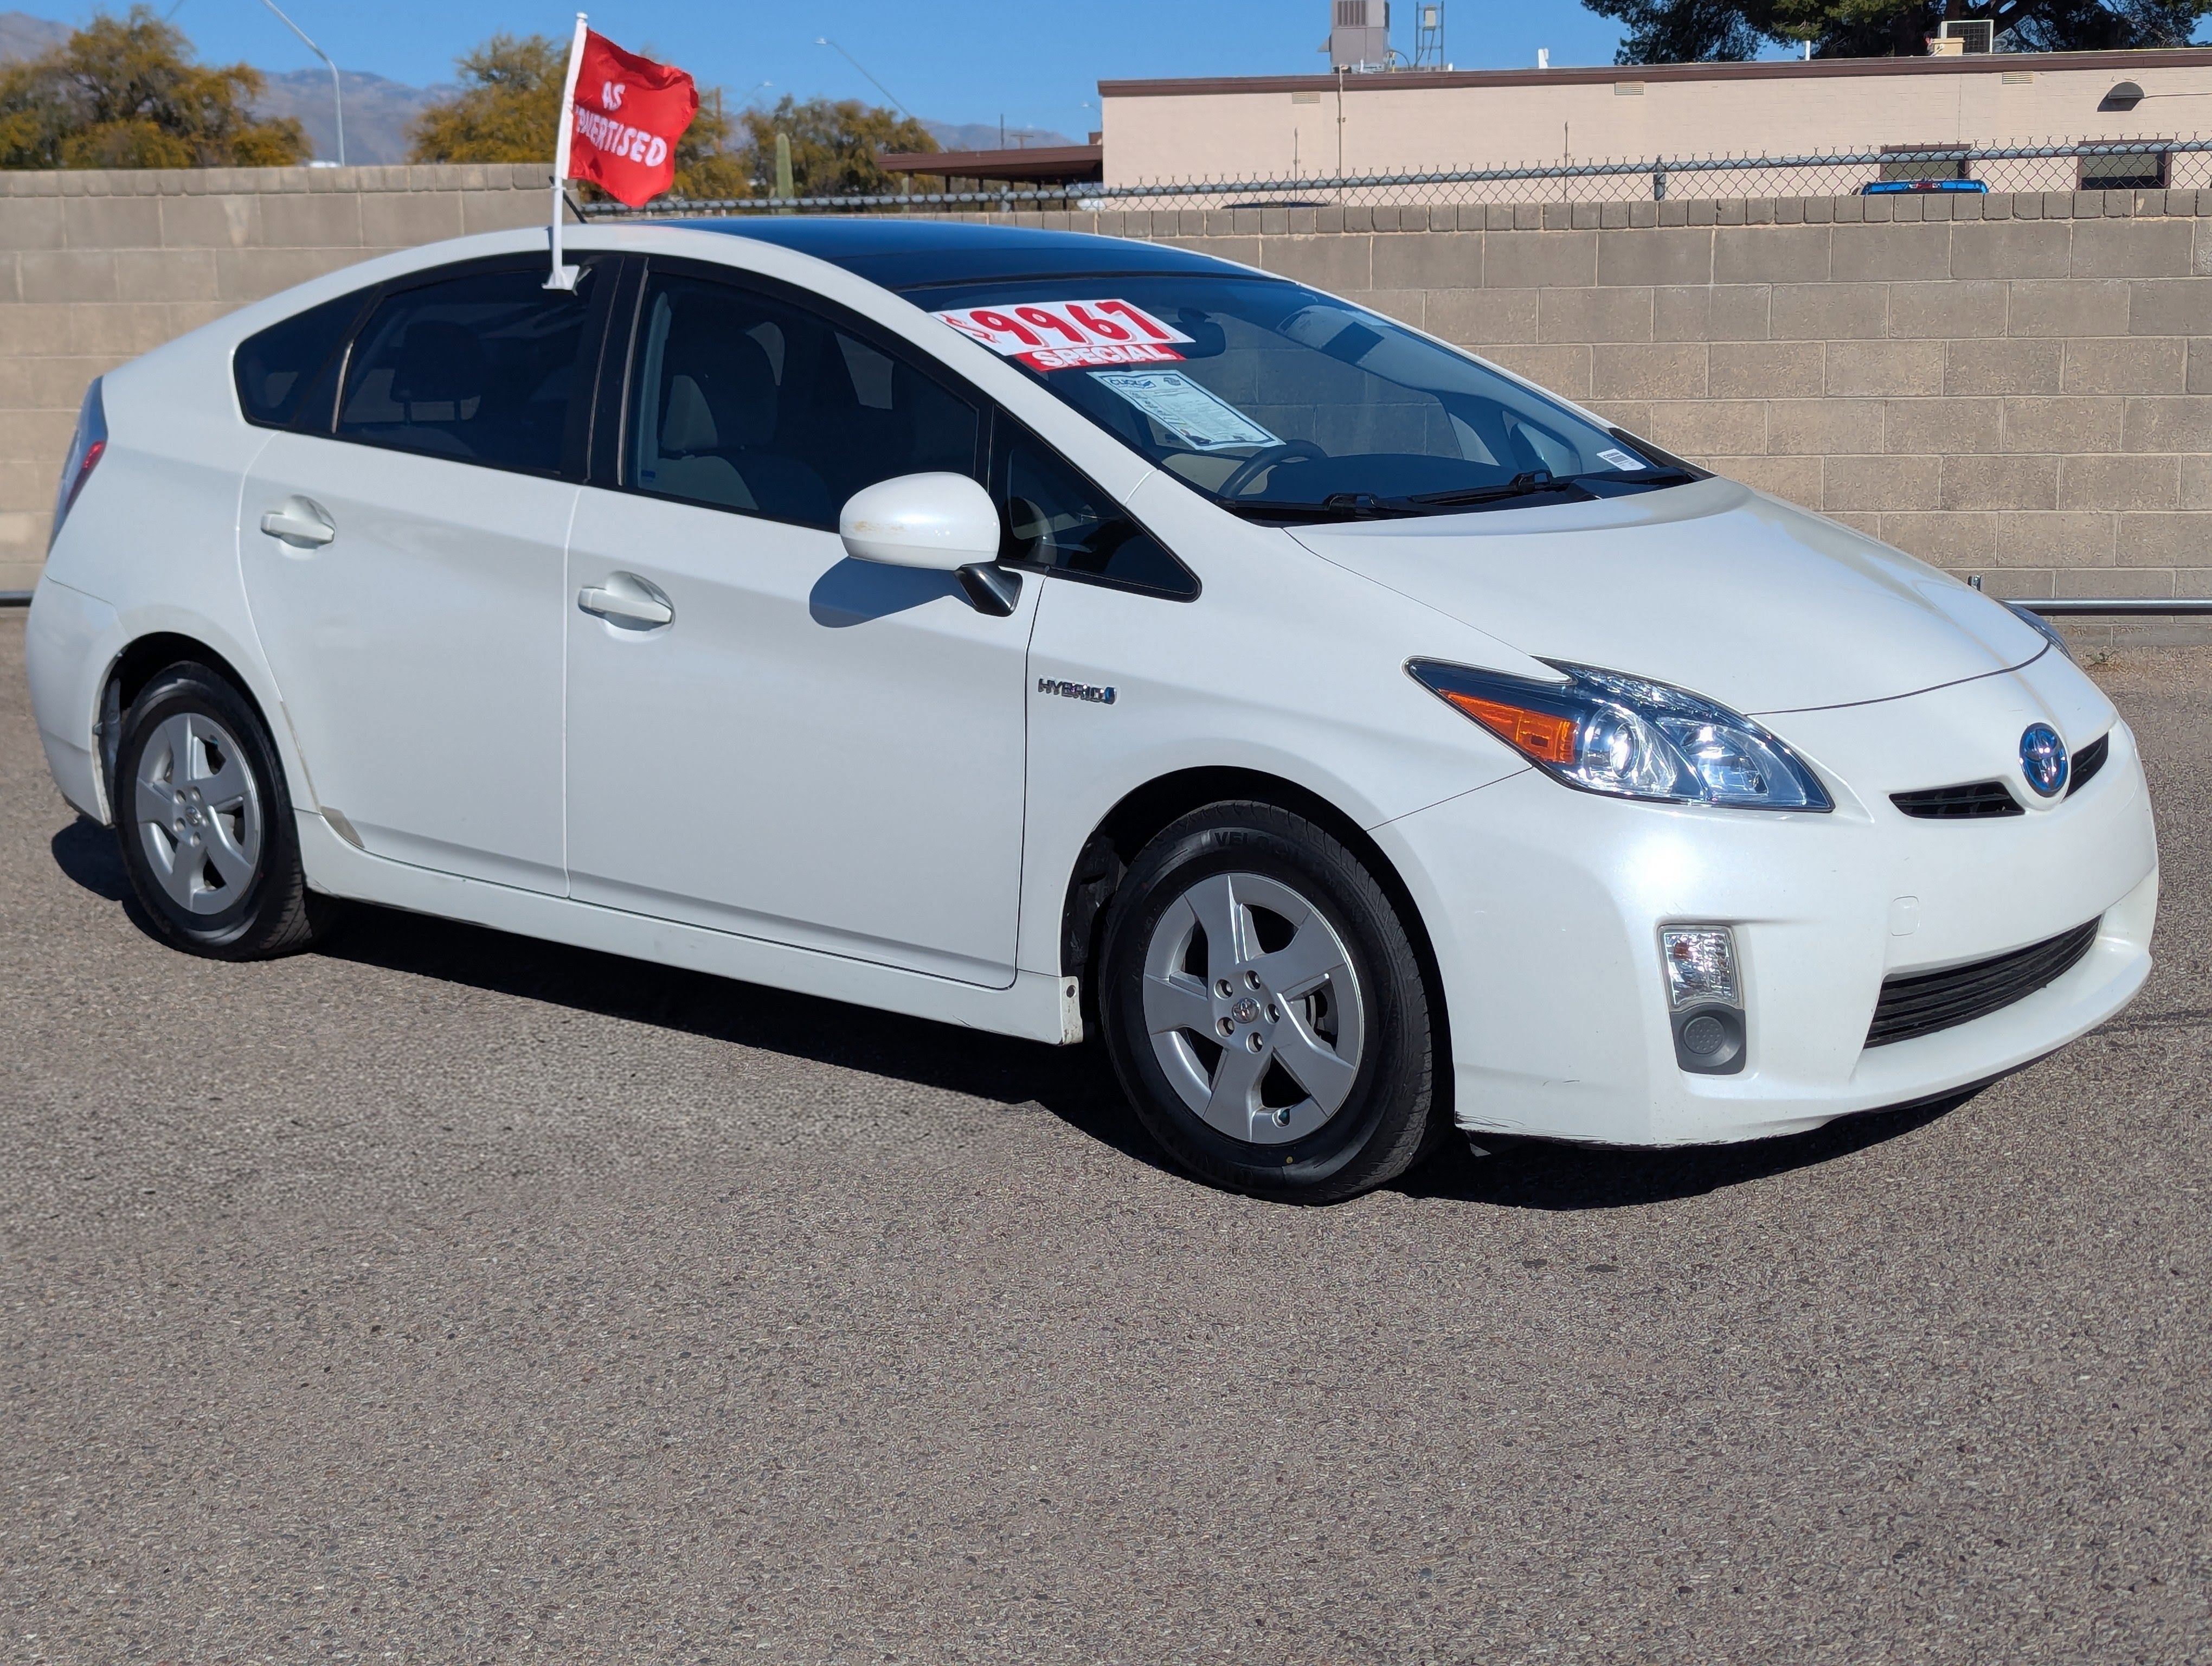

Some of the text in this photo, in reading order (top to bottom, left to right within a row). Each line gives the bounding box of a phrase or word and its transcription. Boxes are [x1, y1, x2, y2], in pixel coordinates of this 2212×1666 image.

[602, 80, 626, 111] AS
[575, 105, 667, 167] DVERTISED
[1032, 344, 1176, 367] SPECIAL
[1038, 678, 1104, 702] HYBRID
